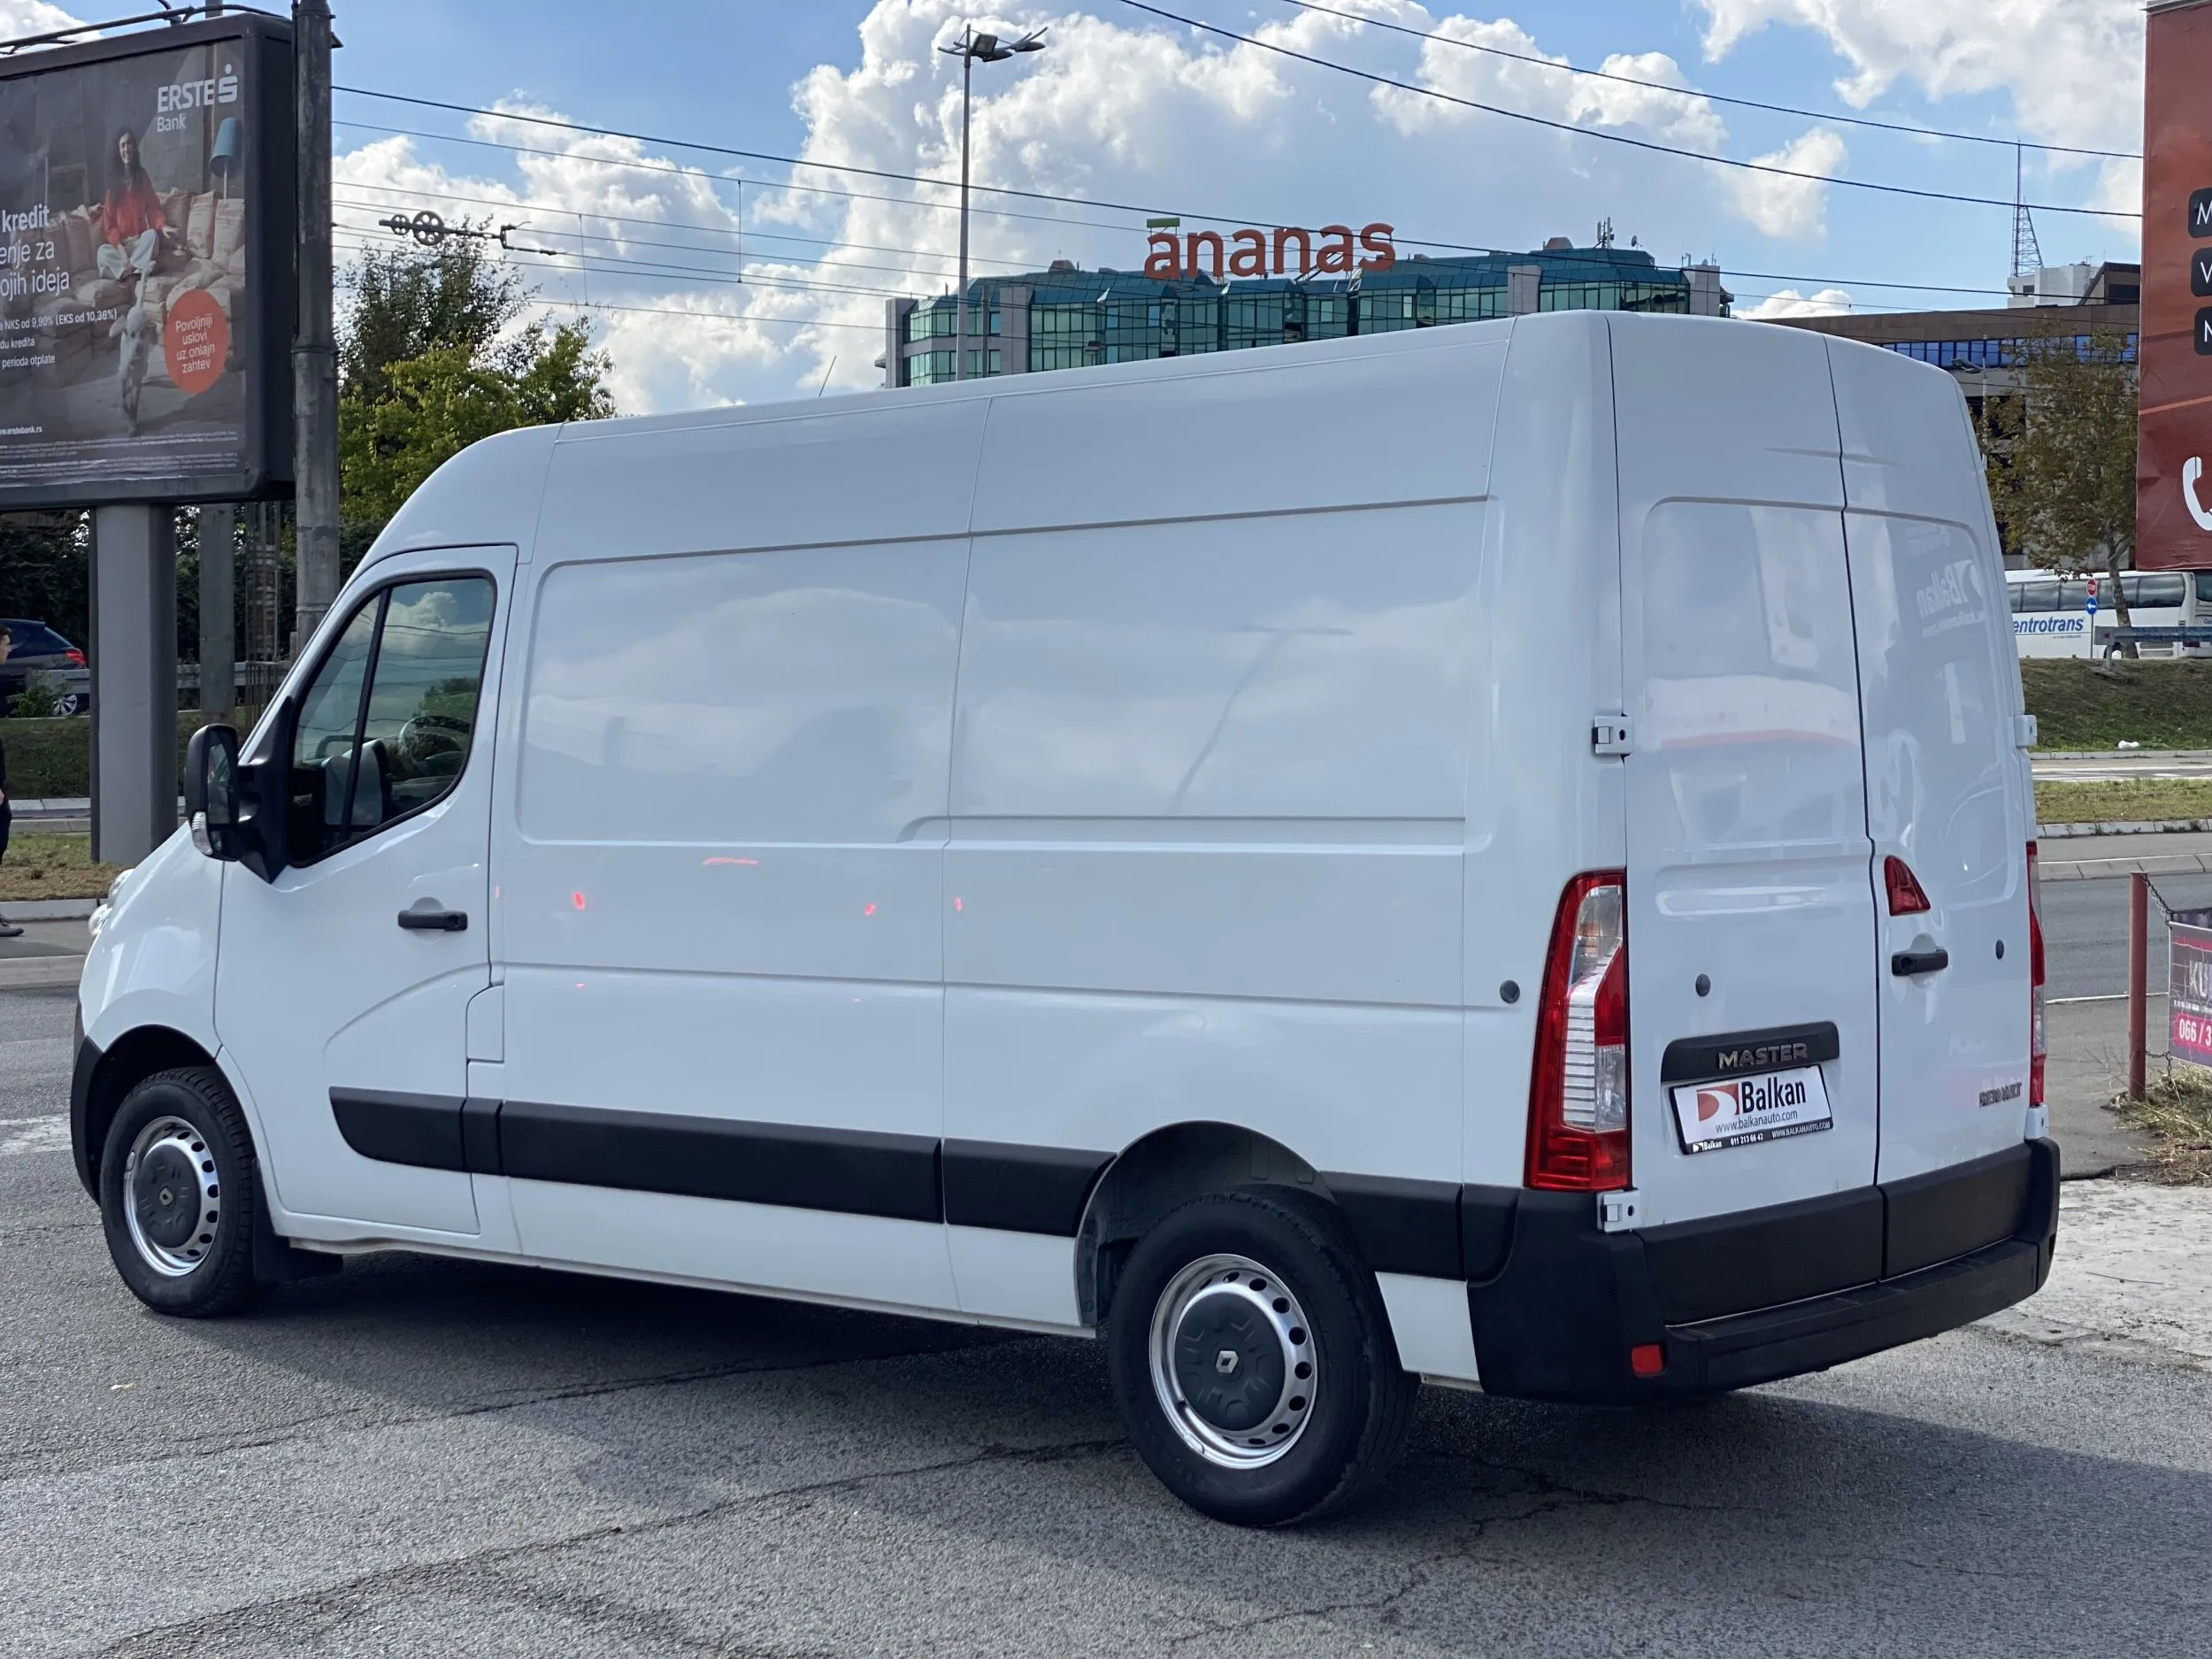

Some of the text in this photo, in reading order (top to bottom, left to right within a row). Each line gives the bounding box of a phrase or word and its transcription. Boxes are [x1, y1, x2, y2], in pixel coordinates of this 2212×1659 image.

[157, 78, 215, 113] ERSTE
[157, 112, 186, 132] Bank
[2, 204, 50, 233] kredit
[35, 240, 55, 260] za
[1144, 221, 1396, 280] ananas
[31, 266, 70, 297] ideja
[4, 319, 20, 330] NKS
[21, 319, 30, 328] od
[56, 313, 74, 326] (EKS
[75, 311, 85, 323] od
[175, 312, 213, 333] Povoljniji
[11, 336, 35, 349] kredita
[182, 328, 208, 345] uslovi
[2, 353, 56, 370] perioda otplate
[176, 342, 216, 361] uz onlajn
[182, 358, 211, 373] zahtev
[2178, 1018, 2197, 1042] 066
[1718, 1042, 1809, 1070] MASTER
[1740, 1076, 1807, 1114] Balkan
[1716, 1110, 1798, 1133] www.balkanauto.com
[1703, 1140, 1723, 1151] Balkan
[1730, 1137, 1740, 1147] 011
[1771, 1120, 1831, 1140] WWW.BALKANAUTO.COM
